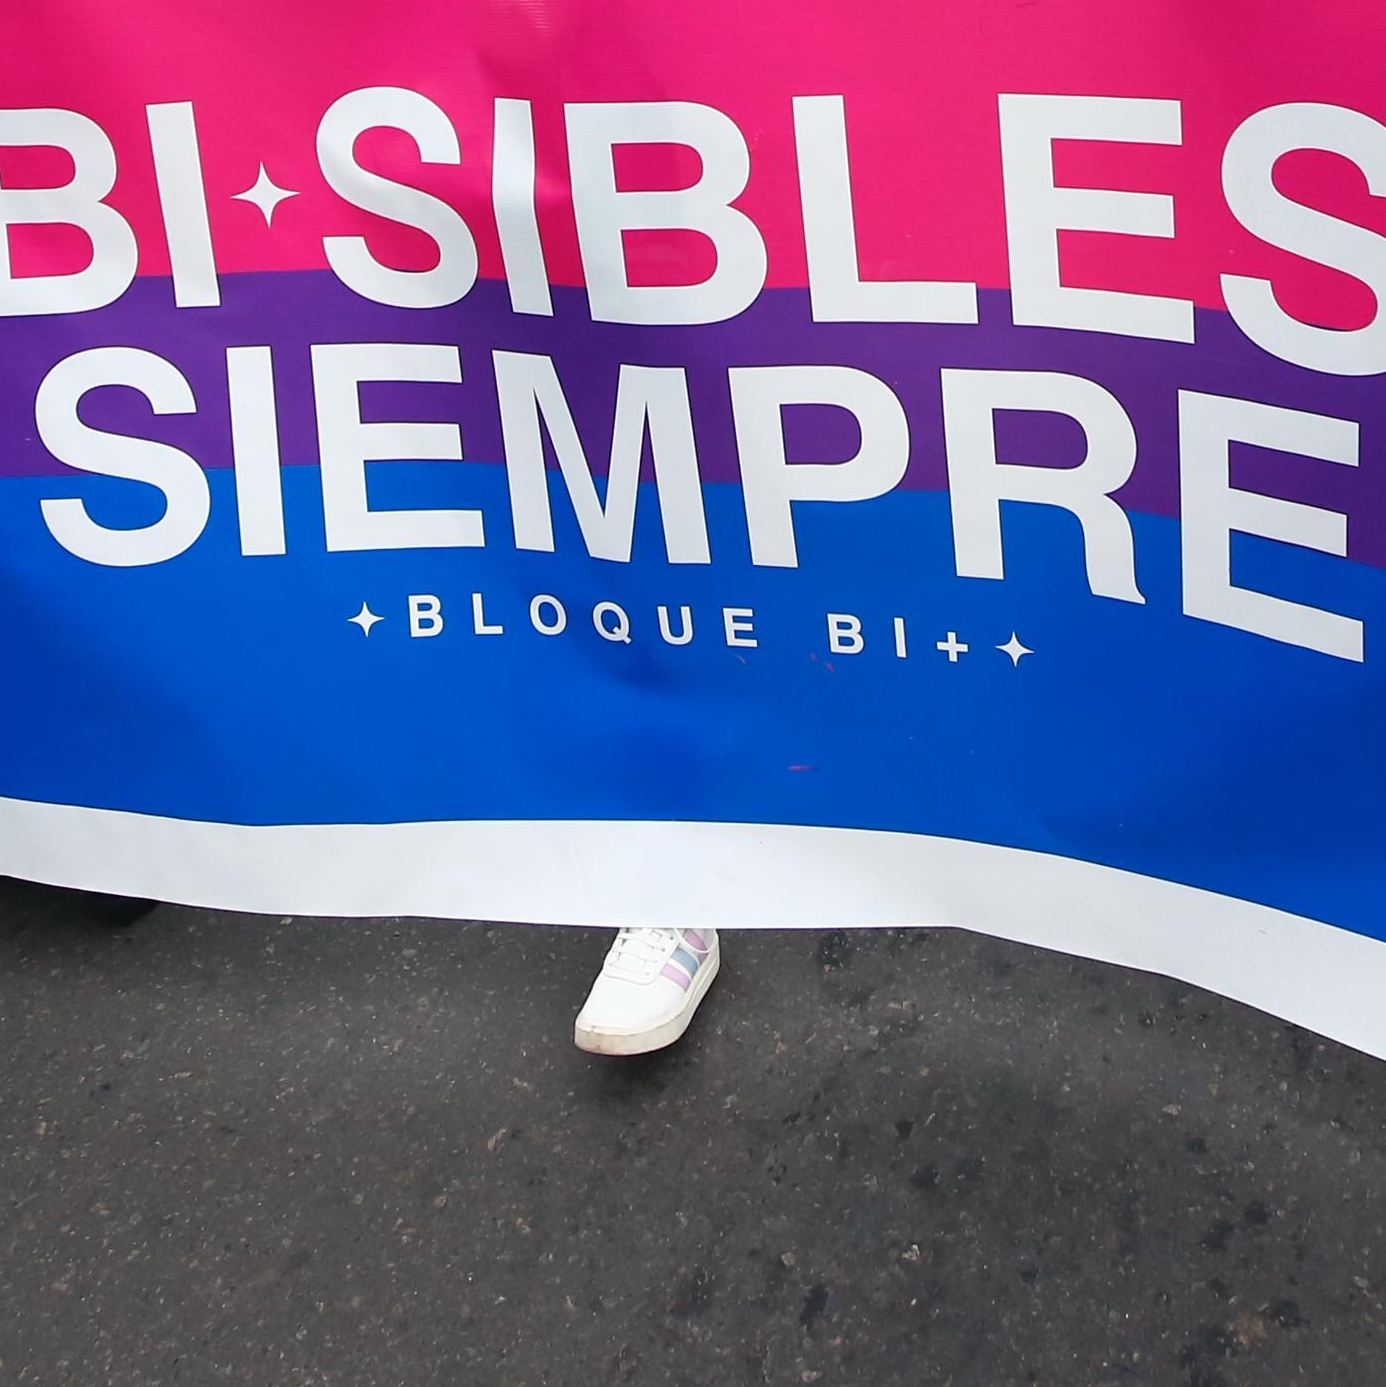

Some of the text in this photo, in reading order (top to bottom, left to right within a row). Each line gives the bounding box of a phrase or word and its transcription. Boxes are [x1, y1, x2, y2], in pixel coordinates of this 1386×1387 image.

[35, 343, 1364, 662] SIEMPRE
[408, 593, 969, 663] BLOQUE BI+
